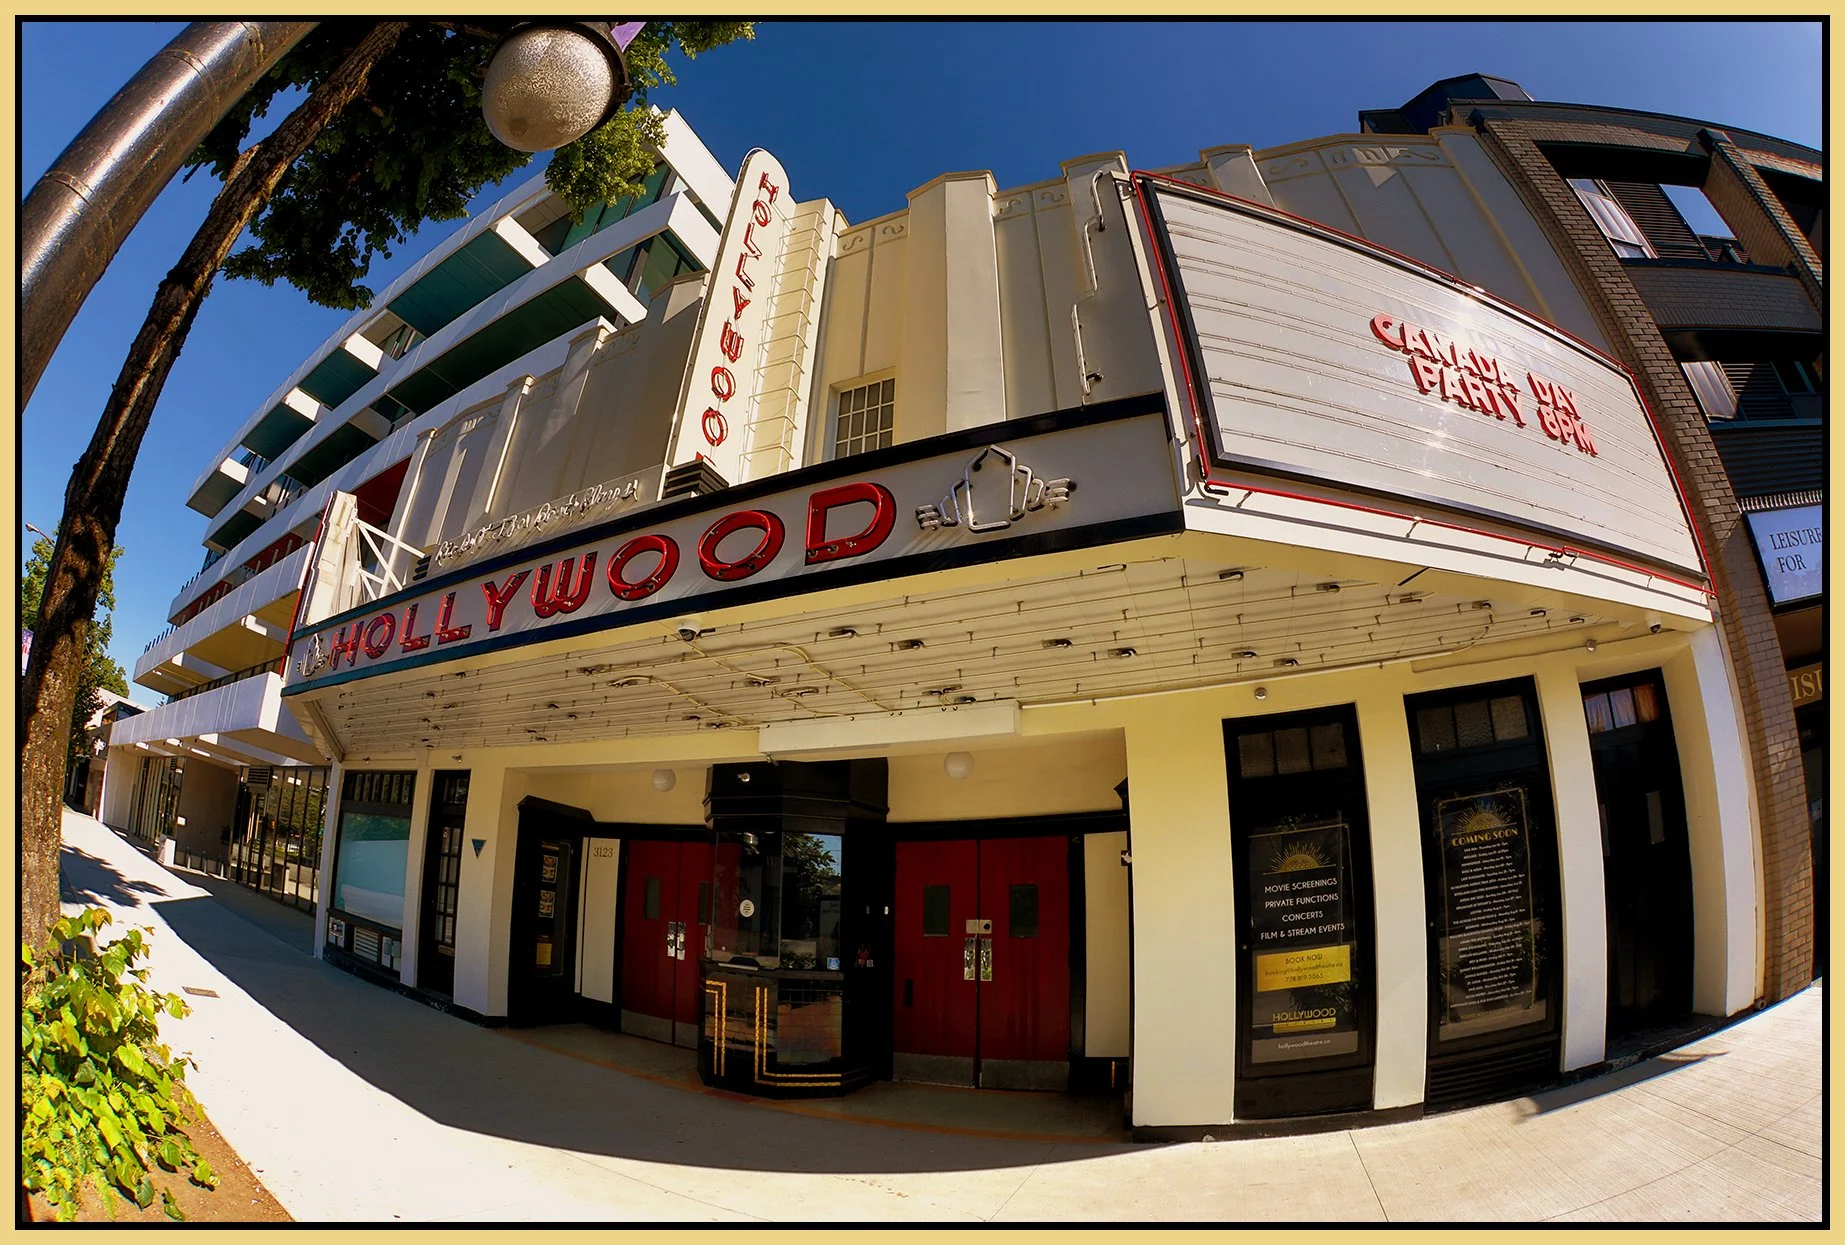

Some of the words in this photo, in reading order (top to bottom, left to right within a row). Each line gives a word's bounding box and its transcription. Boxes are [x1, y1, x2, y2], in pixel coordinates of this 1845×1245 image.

[696, 171, 779, 467] HOLLYWOO
[1369, 312, 1521, 395] CANADA
[1527, 371, 1582, 421] DAY
[1408, 355, 1527, 429] PARTY
[1537, 404, 1598, 458] 8PM
[1777, 553, 1807, 574] FOR
[329, 481, 898, 671] HOLLYWOOD
[1451, 833, 1491, 847] COMING
[1492, 828, 1519, 841] SOON
[593, 846, 614, 858] 3123
[1264, 885, 1290, 894] MOVIE
[1291, 878, 1338, 891] SCREENINGS
[1264, 899, 1294, 909] PRIVATE
[1296, 893, 1339, 906] FUNCTIONS
[1281, 911, 1324, 923] CONCERTS
[1260, 932, 1278, 941] FILM
[1287, 928, 1317, 938] STREAM
[1318, 923, 1345, 934] EVENTS
[1285, 956, 1306, 965] BOOK
[1307, 953, 1323, 962] NOW
[1272, 1007, 1337, 1022] HOLLYWOOD
